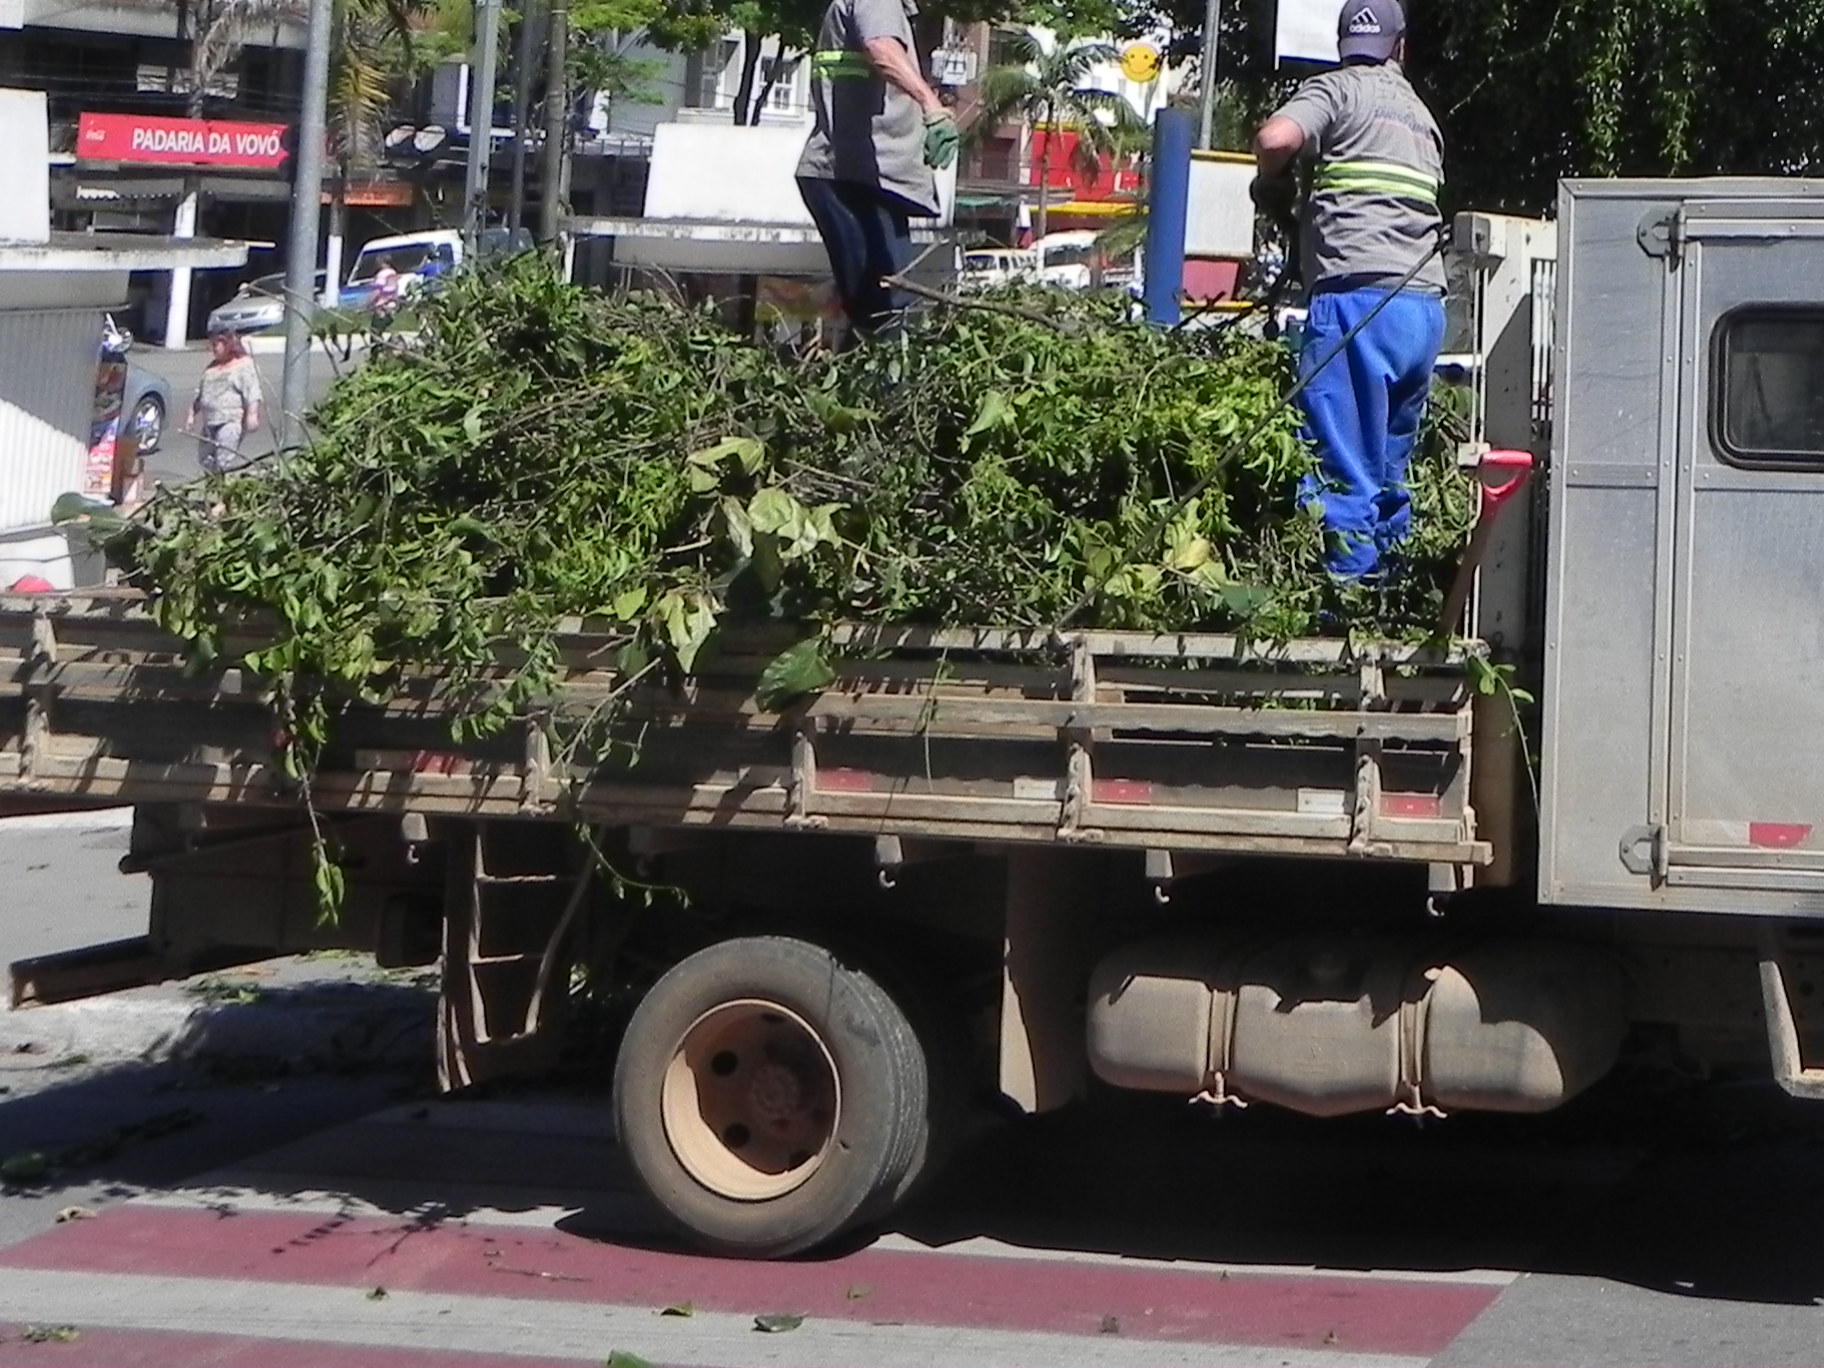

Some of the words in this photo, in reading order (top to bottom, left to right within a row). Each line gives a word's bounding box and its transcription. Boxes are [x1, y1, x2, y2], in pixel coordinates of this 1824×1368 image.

[1350, 24, 1381, 34] adidas
[132, 128, 203, 154] PADARIA
[208, 133, 232, 154] DA
[236, 129, 280, 156] VOVÓ
